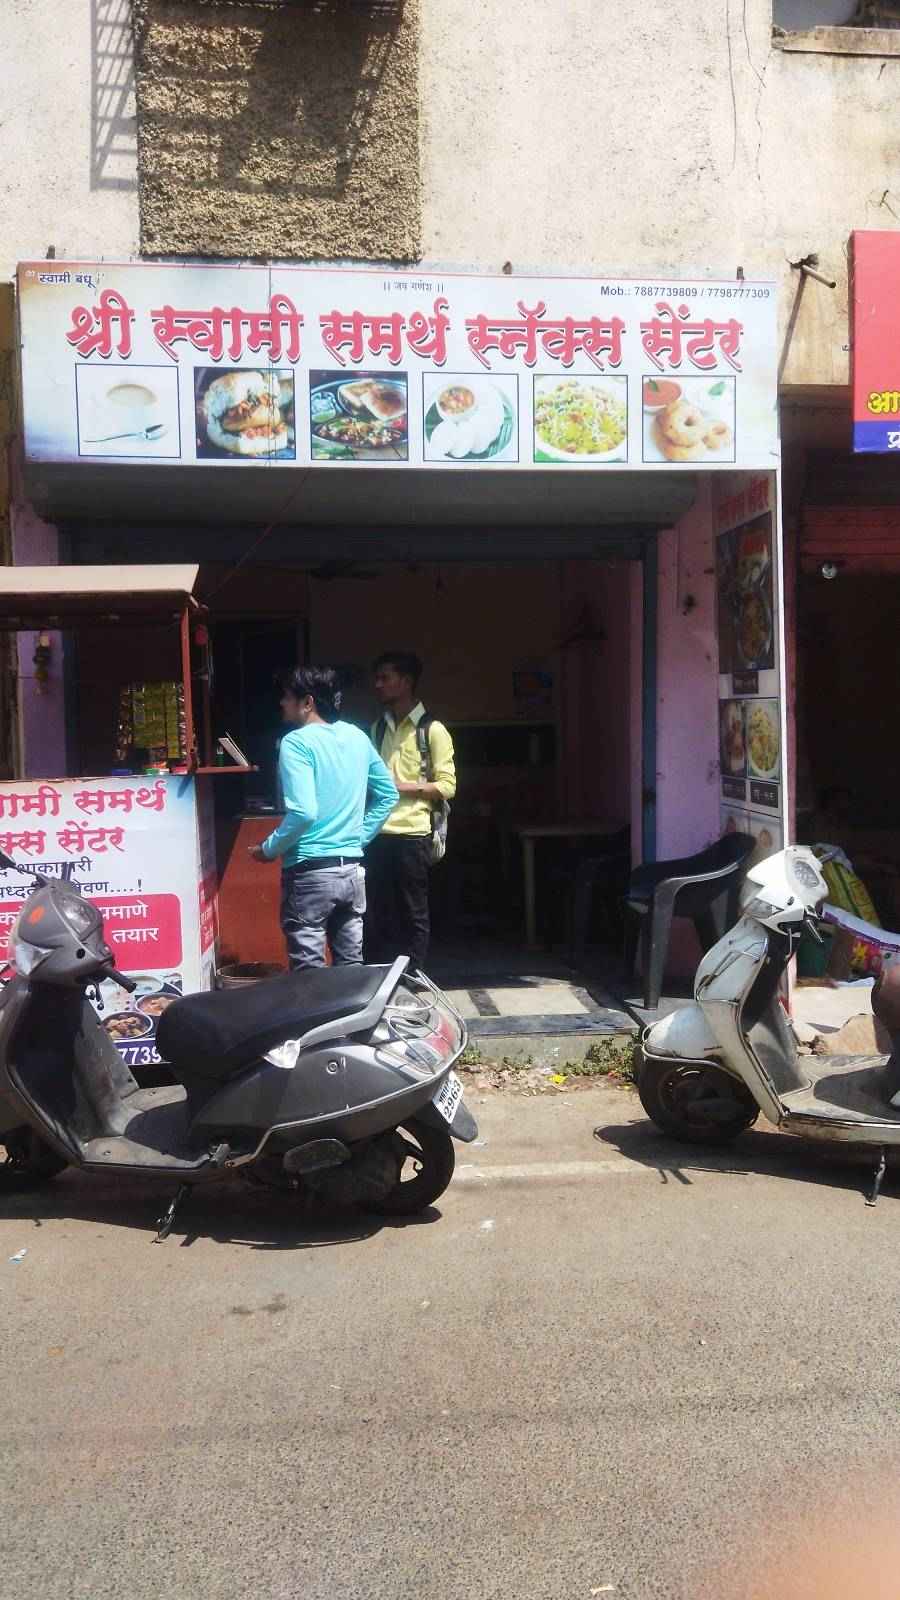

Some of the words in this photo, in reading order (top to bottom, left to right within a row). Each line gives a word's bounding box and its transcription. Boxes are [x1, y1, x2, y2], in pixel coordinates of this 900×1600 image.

[634, 286, 698, 297] 7887739809
[706, 288, 770, 299] 7798777309
[65, 288, 136, 360] श्री
[150, 293, 304, 363] स्वामी
[319, 297, 451, 367] समर्थ
[464, 300, 627, 371] स्नॅक्स
[639, 301, 745, 373] सेंटर
[74, 780, 167, 815] समर्थ
[57, 820, 126, 854] सेंटर
[17, 856, 93, 875] शाकाारी
[111, 927, 160, 943] तयार
